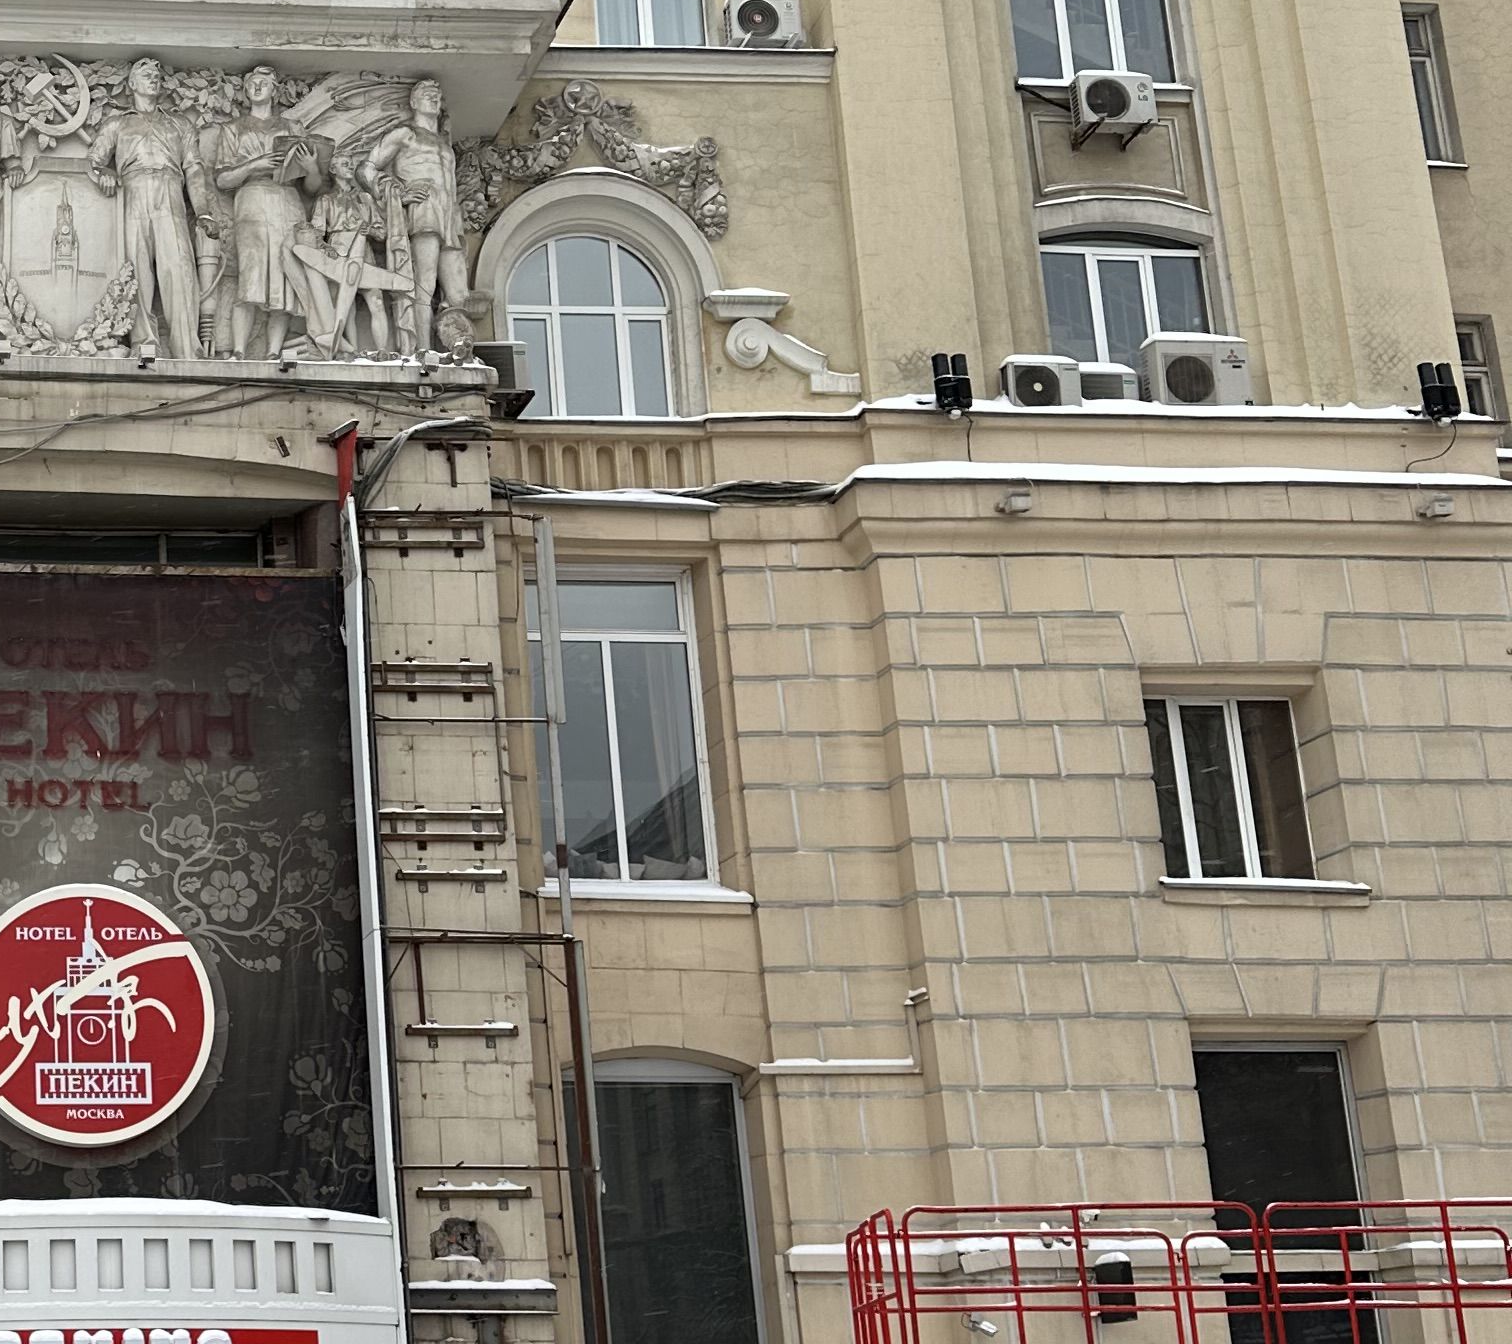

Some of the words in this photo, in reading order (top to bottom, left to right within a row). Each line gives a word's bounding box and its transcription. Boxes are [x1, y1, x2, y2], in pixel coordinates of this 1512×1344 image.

[5, 777, 152, 812] HOTEL
[15, 926, 76, 941] HOTEL
[100, 926, 163, 941] ОТЕЛЬ
[49, 1074, 138, 1093] ПЕКИН
[66, 1108, 125, 1120] МОСКВА
